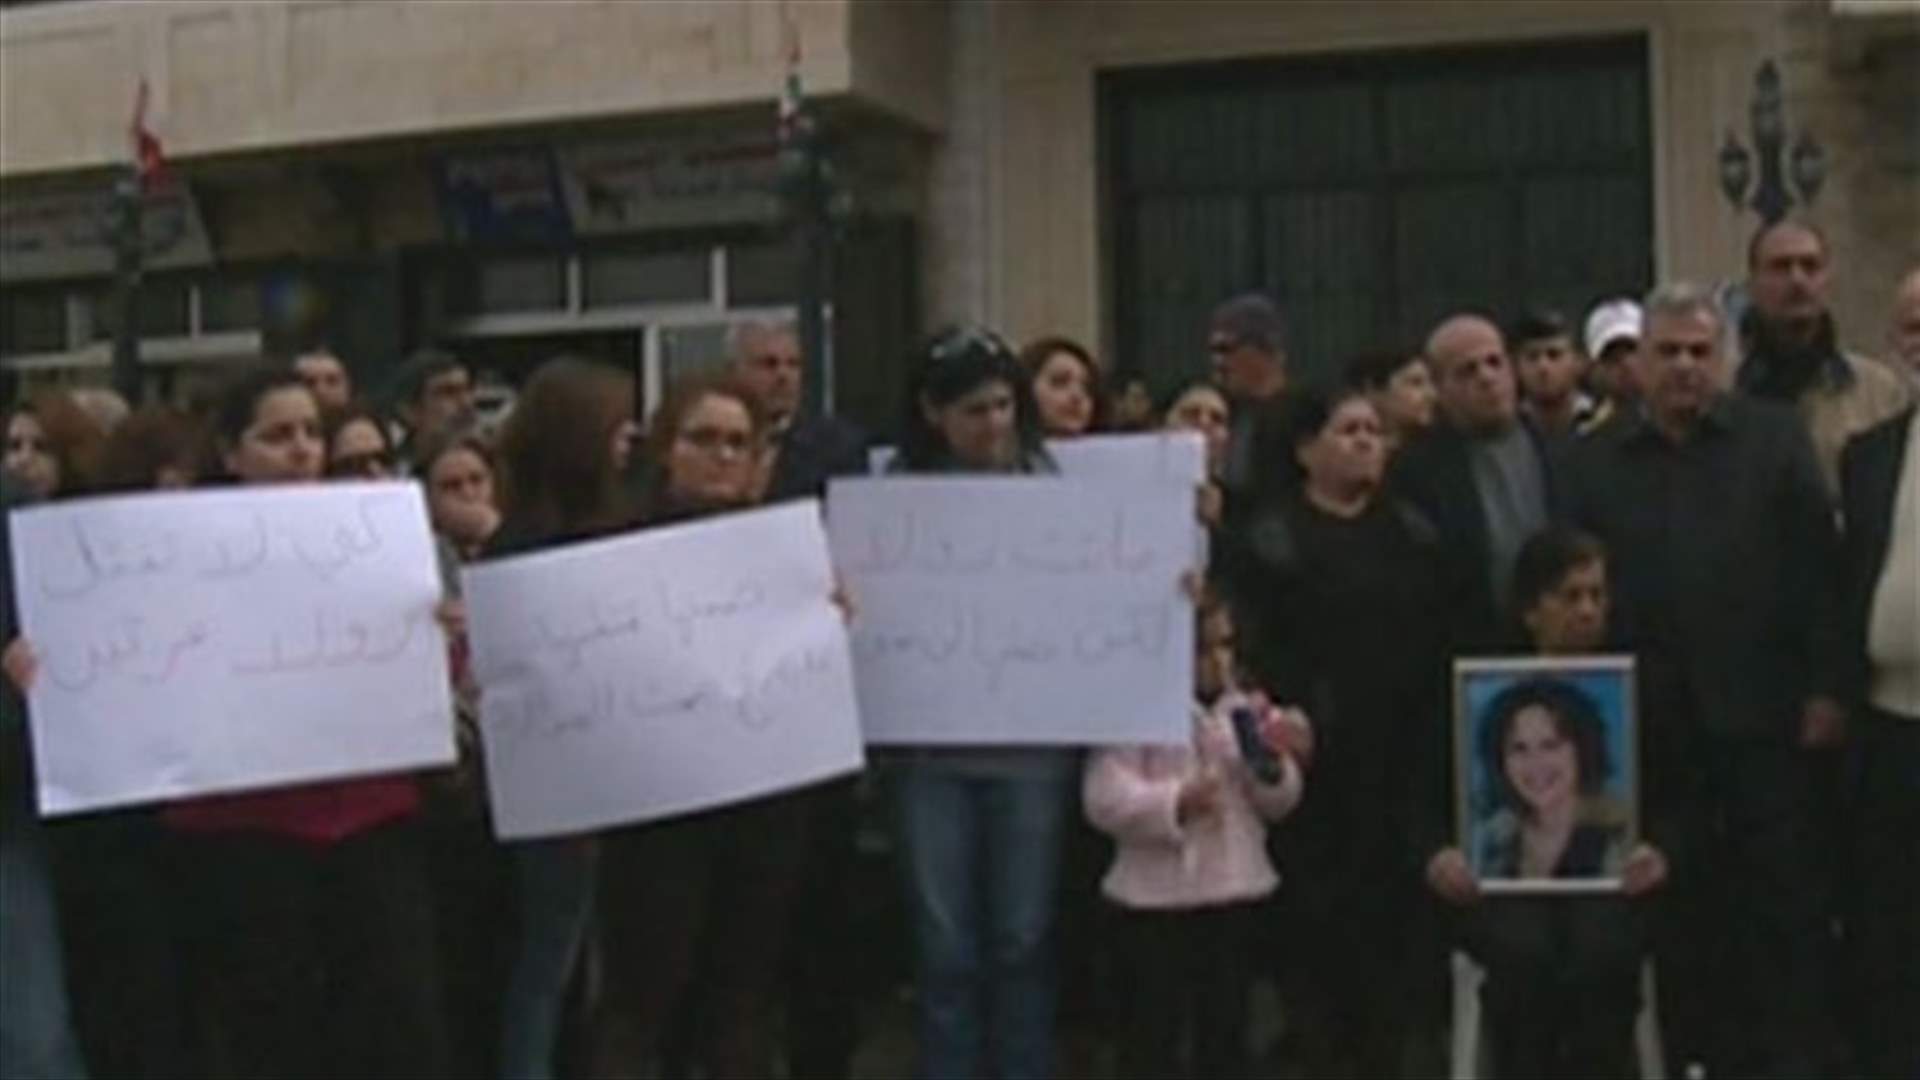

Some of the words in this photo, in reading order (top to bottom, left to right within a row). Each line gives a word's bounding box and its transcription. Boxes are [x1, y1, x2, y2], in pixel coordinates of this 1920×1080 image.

[197, 511, 269, 581] لا
[854, 508, 999, 576] رولا
[1011, 504, 1156, 576] ماتت
